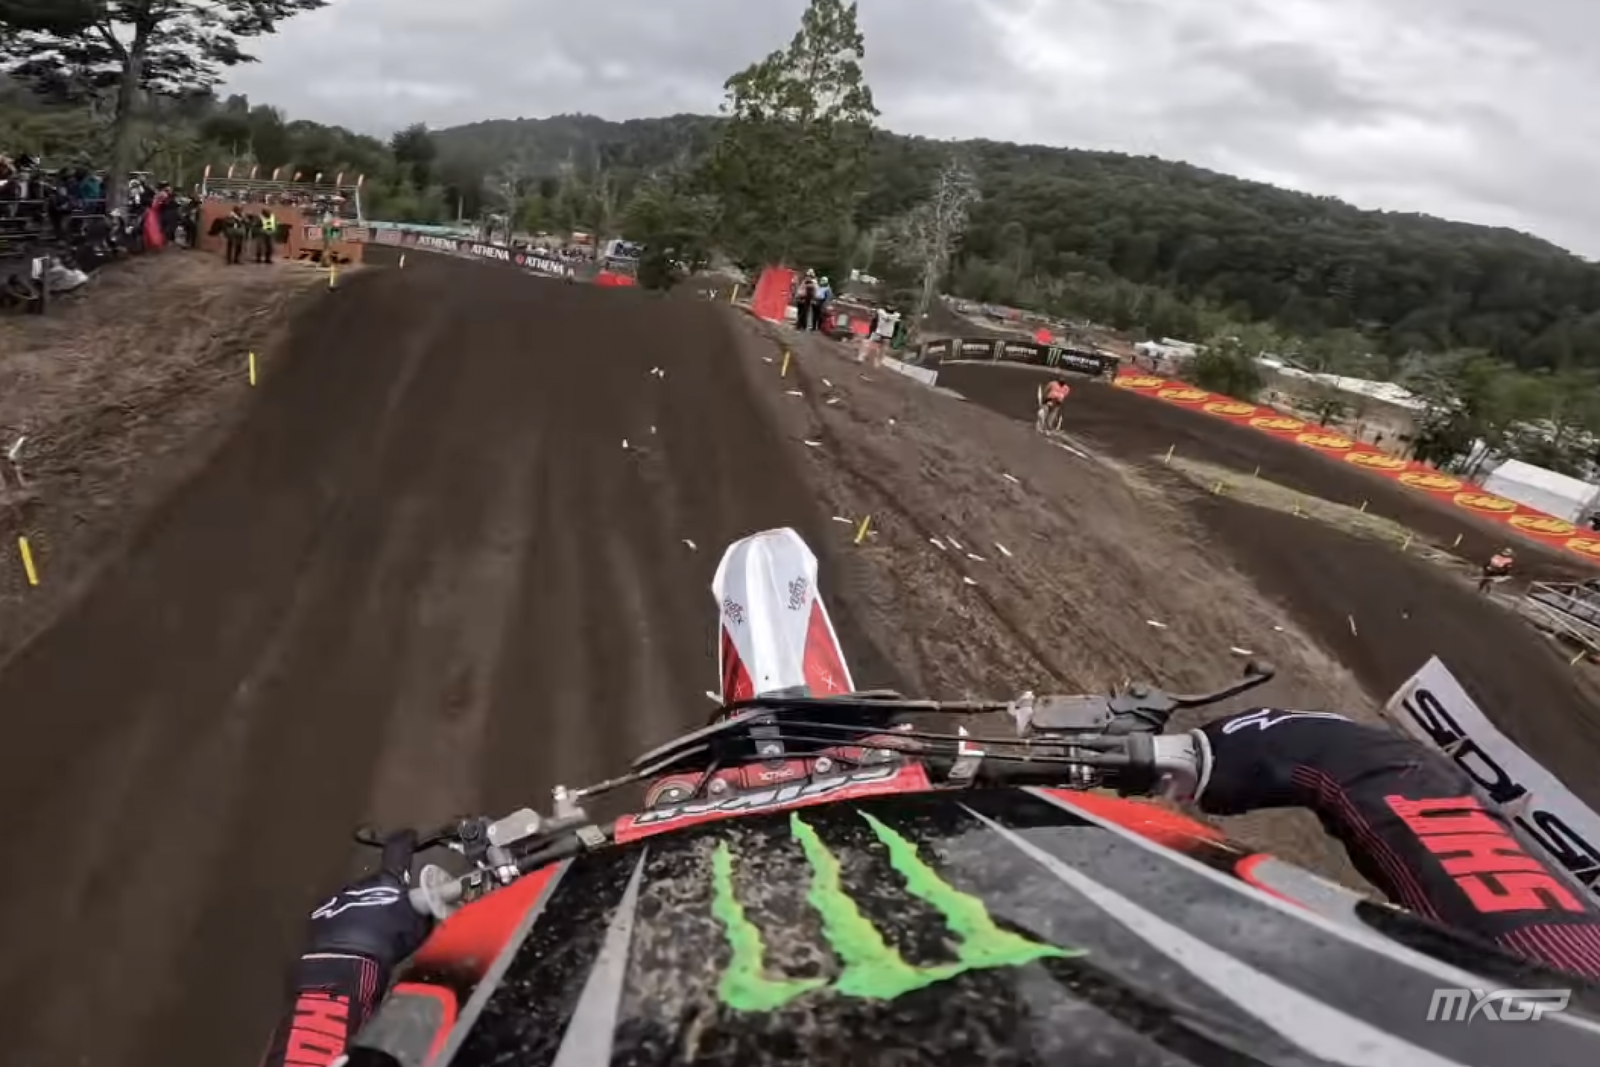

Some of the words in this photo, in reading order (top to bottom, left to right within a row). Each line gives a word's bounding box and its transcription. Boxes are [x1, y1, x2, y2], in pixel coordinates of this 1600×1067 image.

[417, 236, 457, 250] ATHENA
[472, 244, 510, 261] ATHENA
[525, 256, 564, 274] ATHENA
